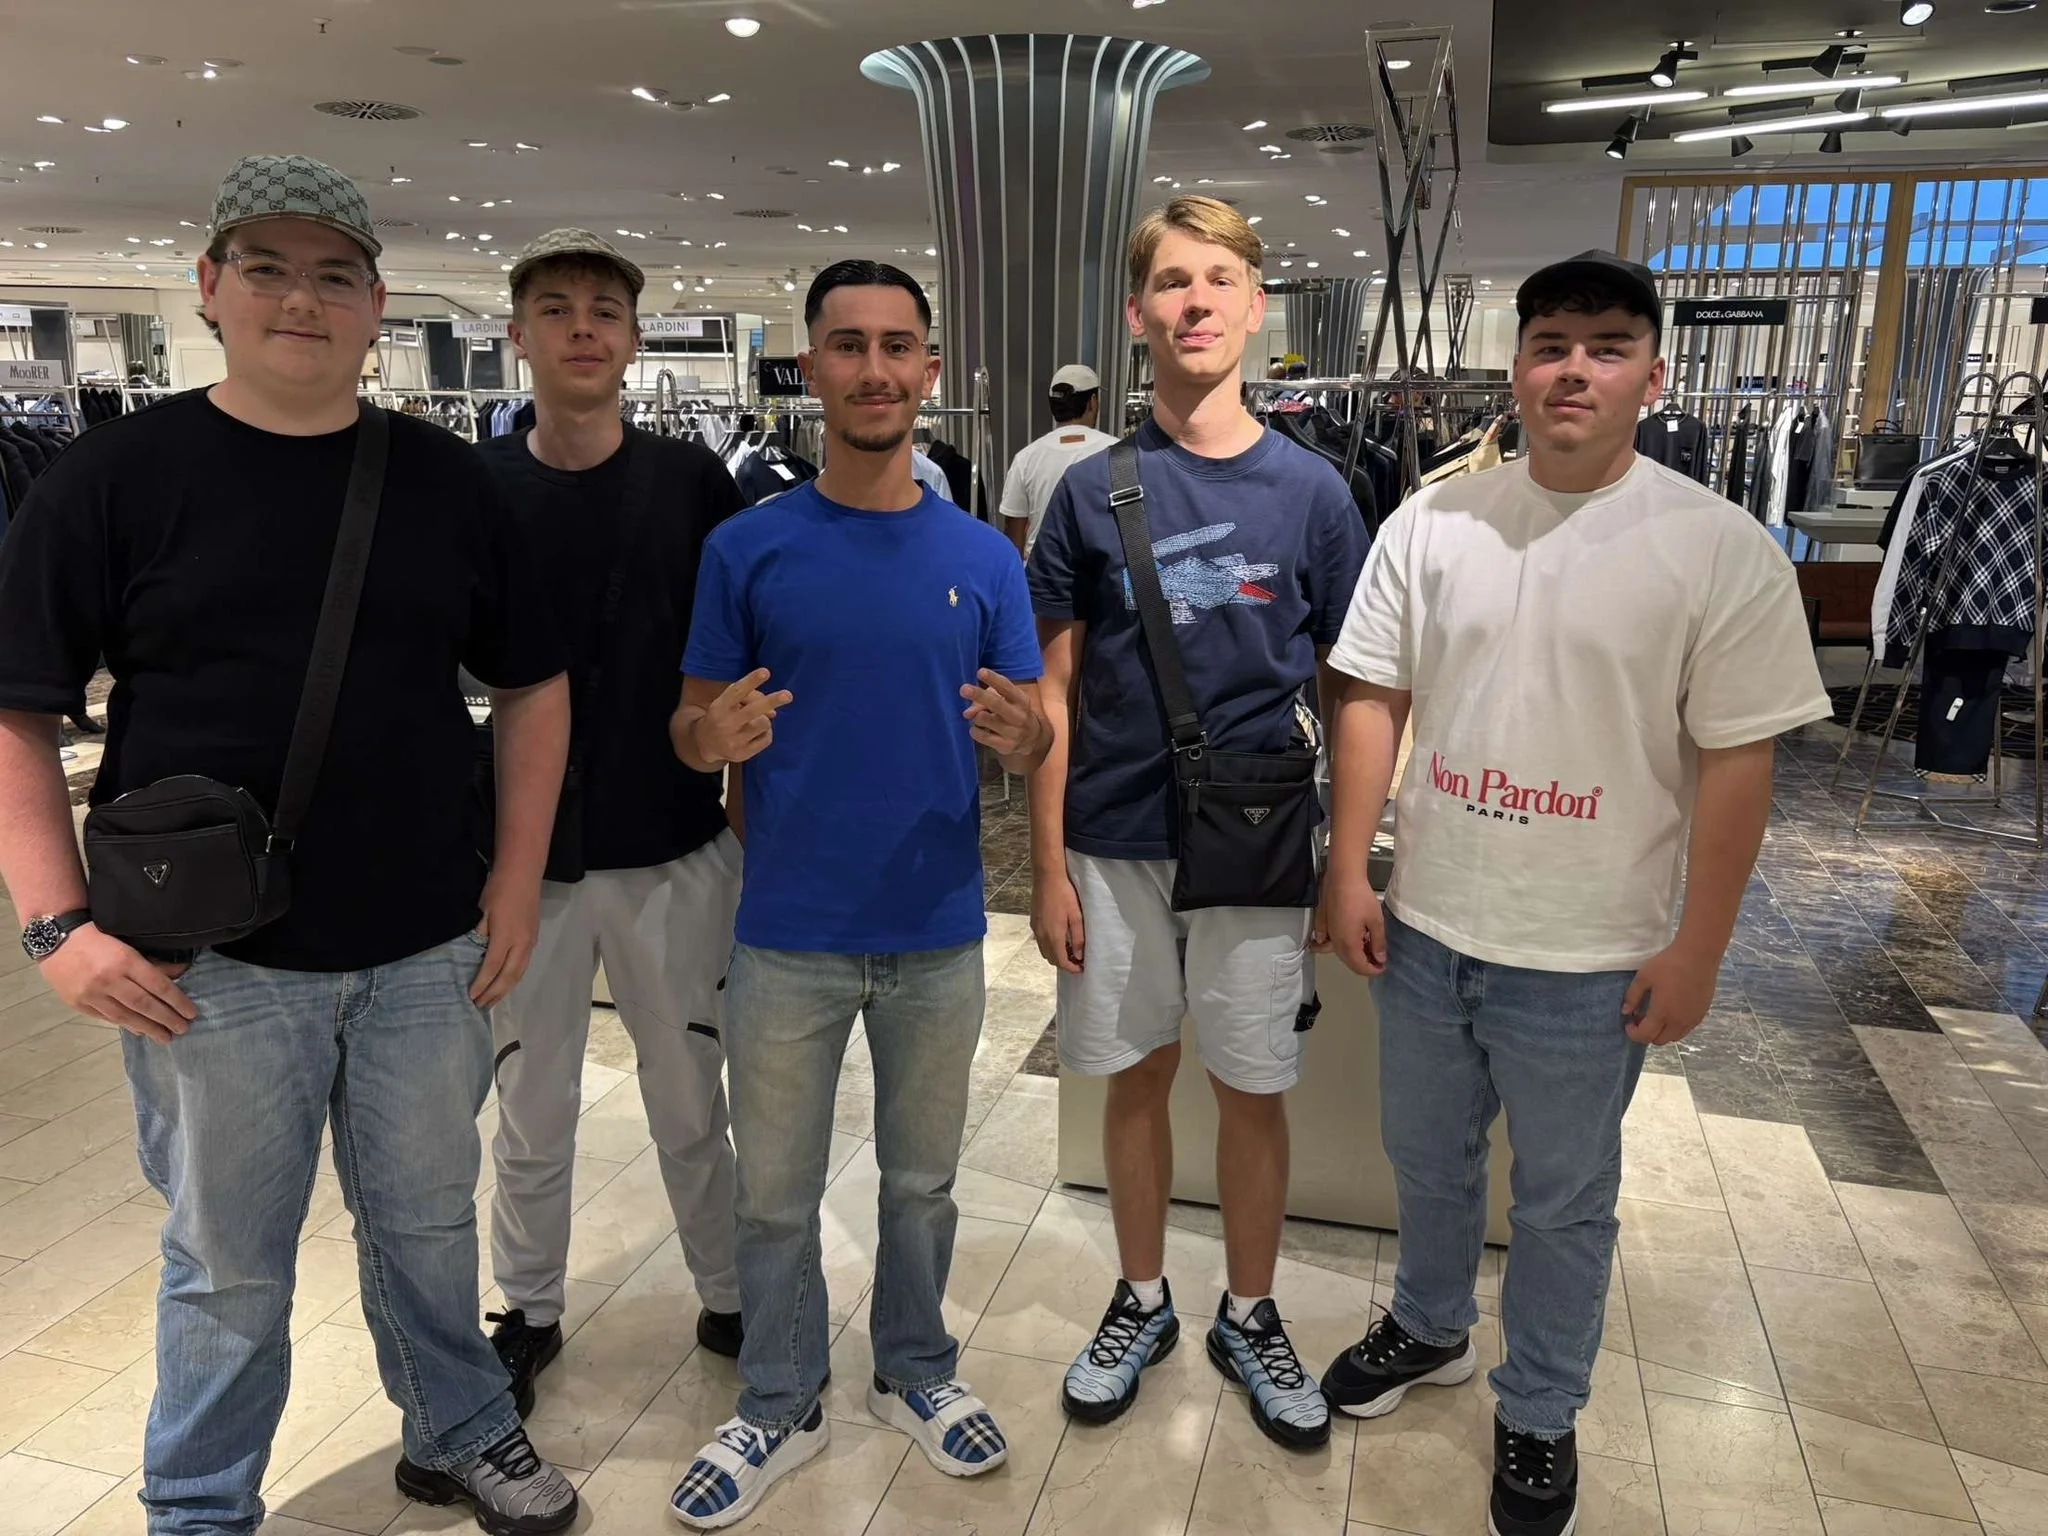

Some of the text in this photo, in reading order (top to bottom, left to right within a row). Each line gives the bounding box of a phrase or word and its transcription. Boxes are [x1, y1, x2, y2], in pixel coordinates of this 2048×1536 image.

[462, 323, 506, 333] LARDINI
[642, 321, 690, 333] LARDINI
[1426, 751, 1469, 799] Non
[1466, 804, 1530, 825] PARIS
